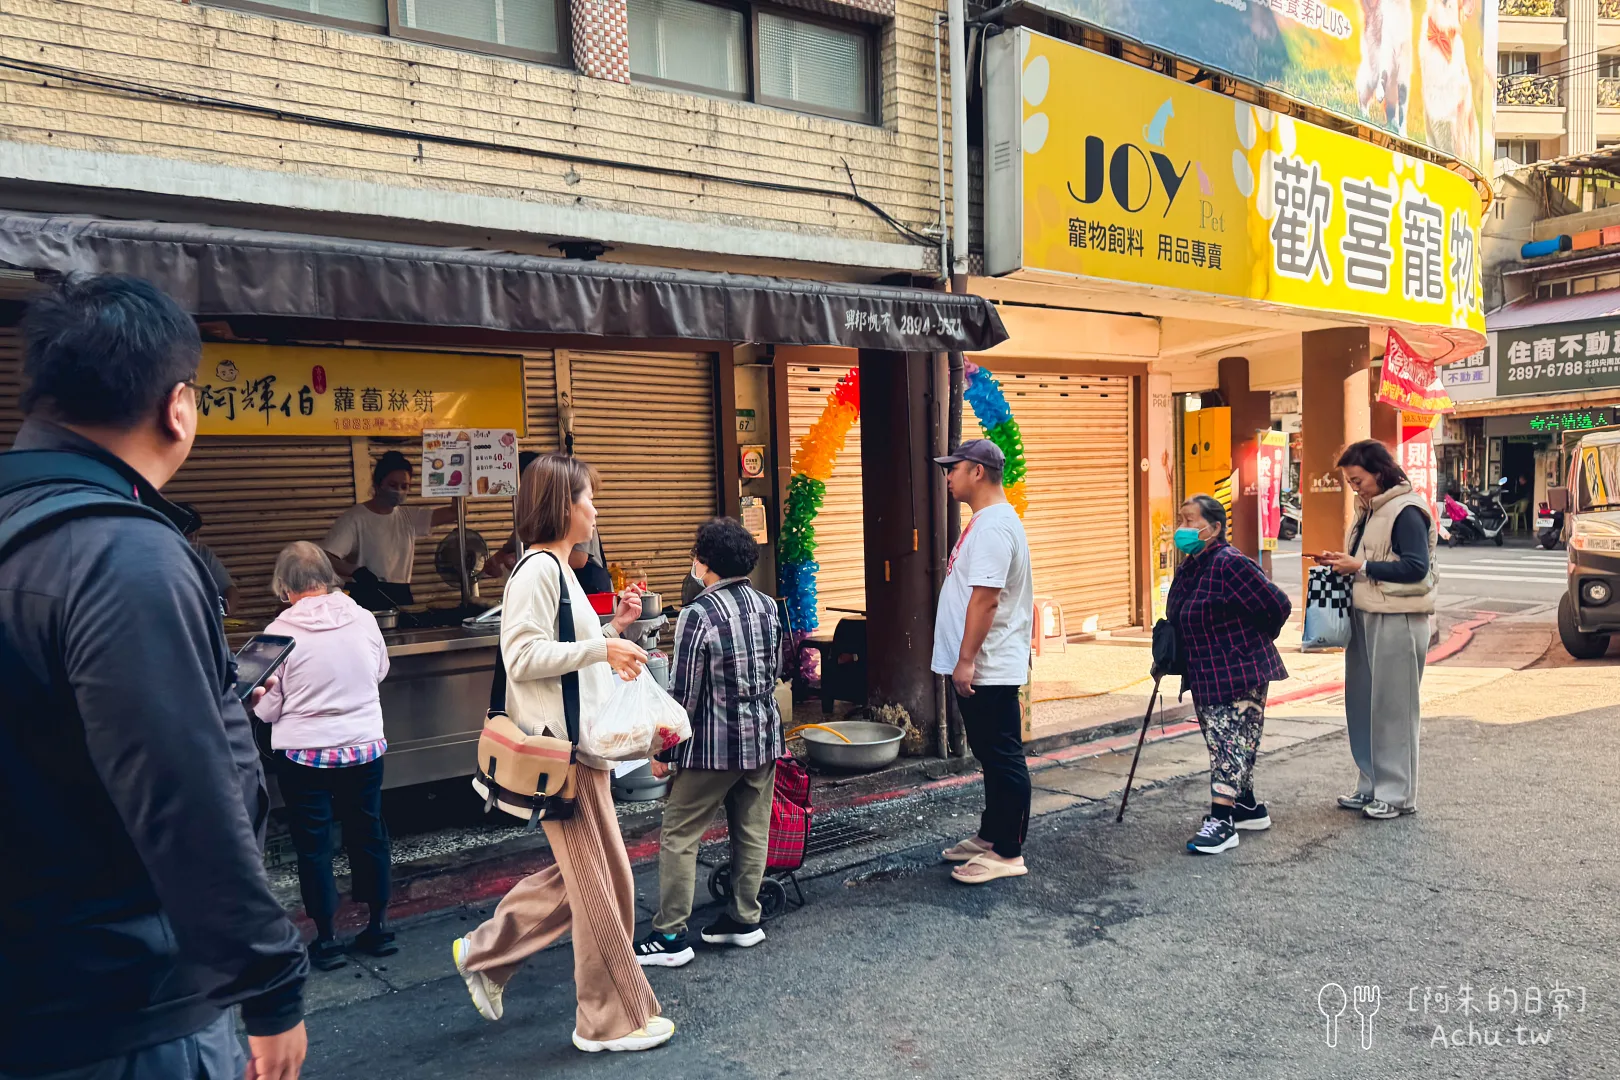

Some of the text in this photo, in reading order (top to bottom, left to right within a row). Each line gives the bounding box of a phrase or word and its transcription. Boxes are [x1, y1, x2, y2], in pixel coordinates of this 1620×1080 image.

[1067, 135, 1191, 218] JOY
[1199, 200, 1226, 233] Pet
[1272, 156, 1483, 309] 歡喜寵物
[1068, 217, 1222, 270] 寵物飼料 用品專賣
[1448, 370, 1483, 384] 不動產
[1508, 361, 1583, 382] 2897-6788
[197, 375, 313, 426] 阿輝伯
[739, 420, 750, 431] 67
